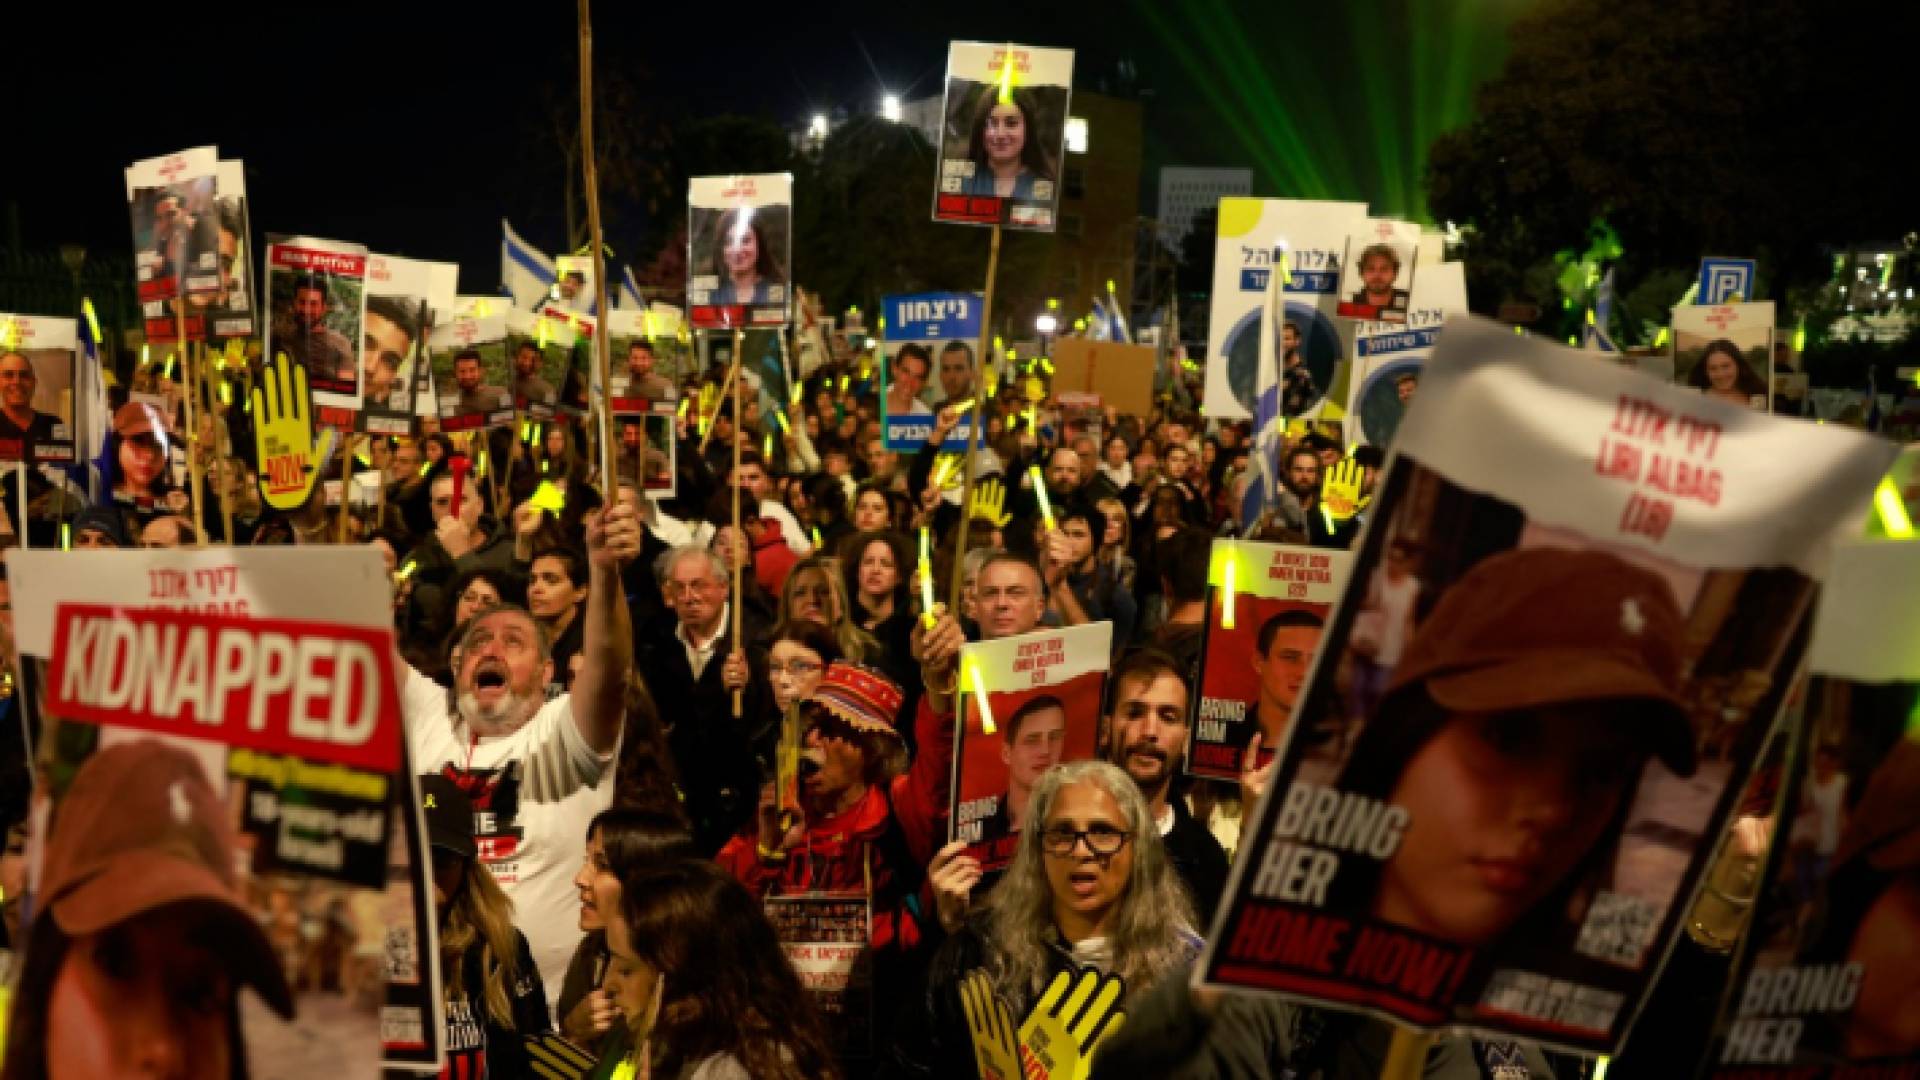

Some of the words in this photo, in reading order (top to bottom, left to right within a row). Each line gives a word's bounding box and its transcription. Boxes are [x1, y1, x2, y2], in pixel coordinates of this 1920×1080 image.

[898, 299, 968, 328] ניצחון
[1645, 453, 1723, 507] ALBAG
[60, 614, 381, 746] KIDNAPPED
[1196, 719, 1227, 743] HIM
[1201, 697, 1246, 721] BRING
[958, 796, 997, 823] BRING
[1275, 782, 1409, 860] BRING
[1252, 839, 1340, 907] HER
[1229, 903, 1349, 973] HOME
[1346, 926, 1474, 1004] NOW!
[1740, 963, 1866, 1014] BRING
[1721, 1018, 1804, 1065] HER
